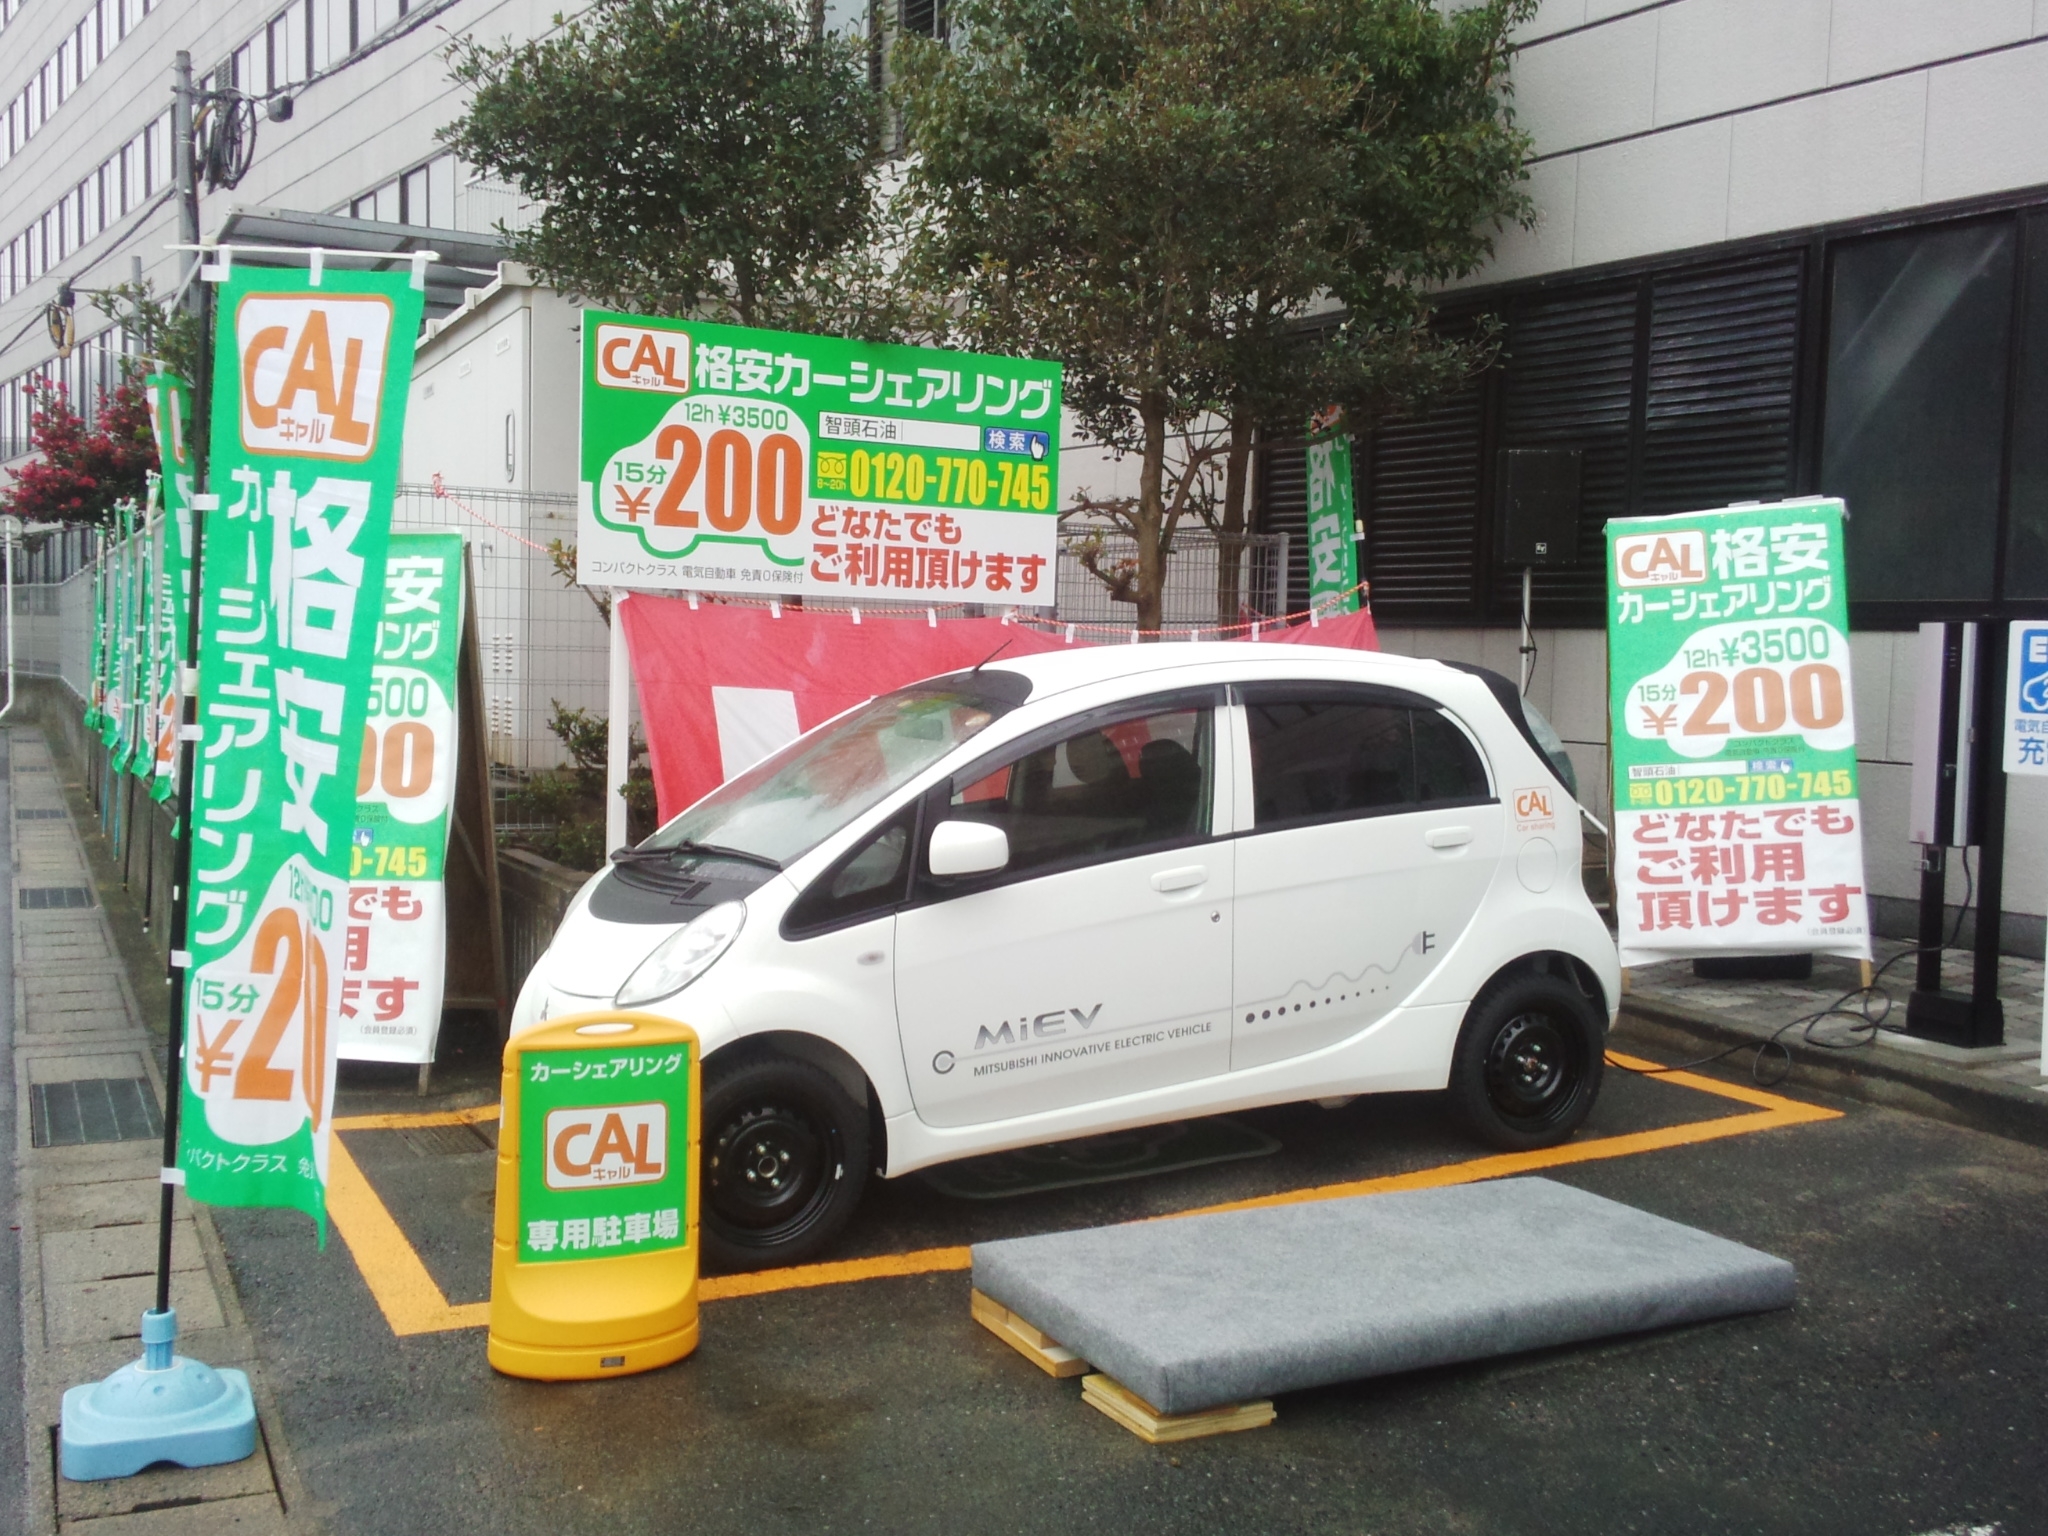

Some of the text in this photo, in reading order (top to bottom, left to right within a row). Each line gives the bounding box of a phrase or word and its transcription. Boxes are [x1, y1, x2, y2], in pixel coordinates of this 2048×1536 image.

[243, 310, 370, 446] CAL
[602, 333, 686, 389] CAL
[632, 374, 661, 387] キャル
[695, 343, 1052, 419] 格安カーシェアリング
[279, 416, 325, 444] キャル
[825, 415, 897, 440] 智頭石油
[988, 430, 1026, 450] 検索
[613, 424, 804, 536] ¥200
[614, 462, 668, 484] 15分
[850, 449, 1050, 510] 0120-770-745
[810, 505, 963, 546] どなたでも
[591, 561, 678, 577] コンパクトクラス
[682, 565, 737, 581] 電気自動車
[810, 541, 1047, 593] ご利用頂けます
[1621, 537, 1704, 580] CAL
[1711, 521, 1829, 581] 格安
[384, 555, 444, 615] 安
[1617, 576, 1831, 624] カーシェアリング
[267, 469, 372, 857] 格安
[1638, 684, 1677, 703] 15分
[1642, 663, 1845, 737] ¥200
[1631, 766, 1676, 778] 智頭石油
[1655, 769, 1852, 806] 0120-770-745
[1516, 790, 1552, 817] CAL
[1633, 805, 1854, 844] どなたでも
[1637, 842, 1806, 886] ご利用
[1637, 883, 1862, 932] 頂けます
[197, 977, 260, 1013] 15分
[530, 1053, 682, 1083] カーシェアリング
[973, 1021, 1212, 1077] MITSUBISHI INNOVATIVE ELECTRIC VEHICLE
[553, 1112, 662, 1177] CAL
[593, 1166, 631, 1181] キャル
[527, 1208, 679, 1252] 専用駐車場
